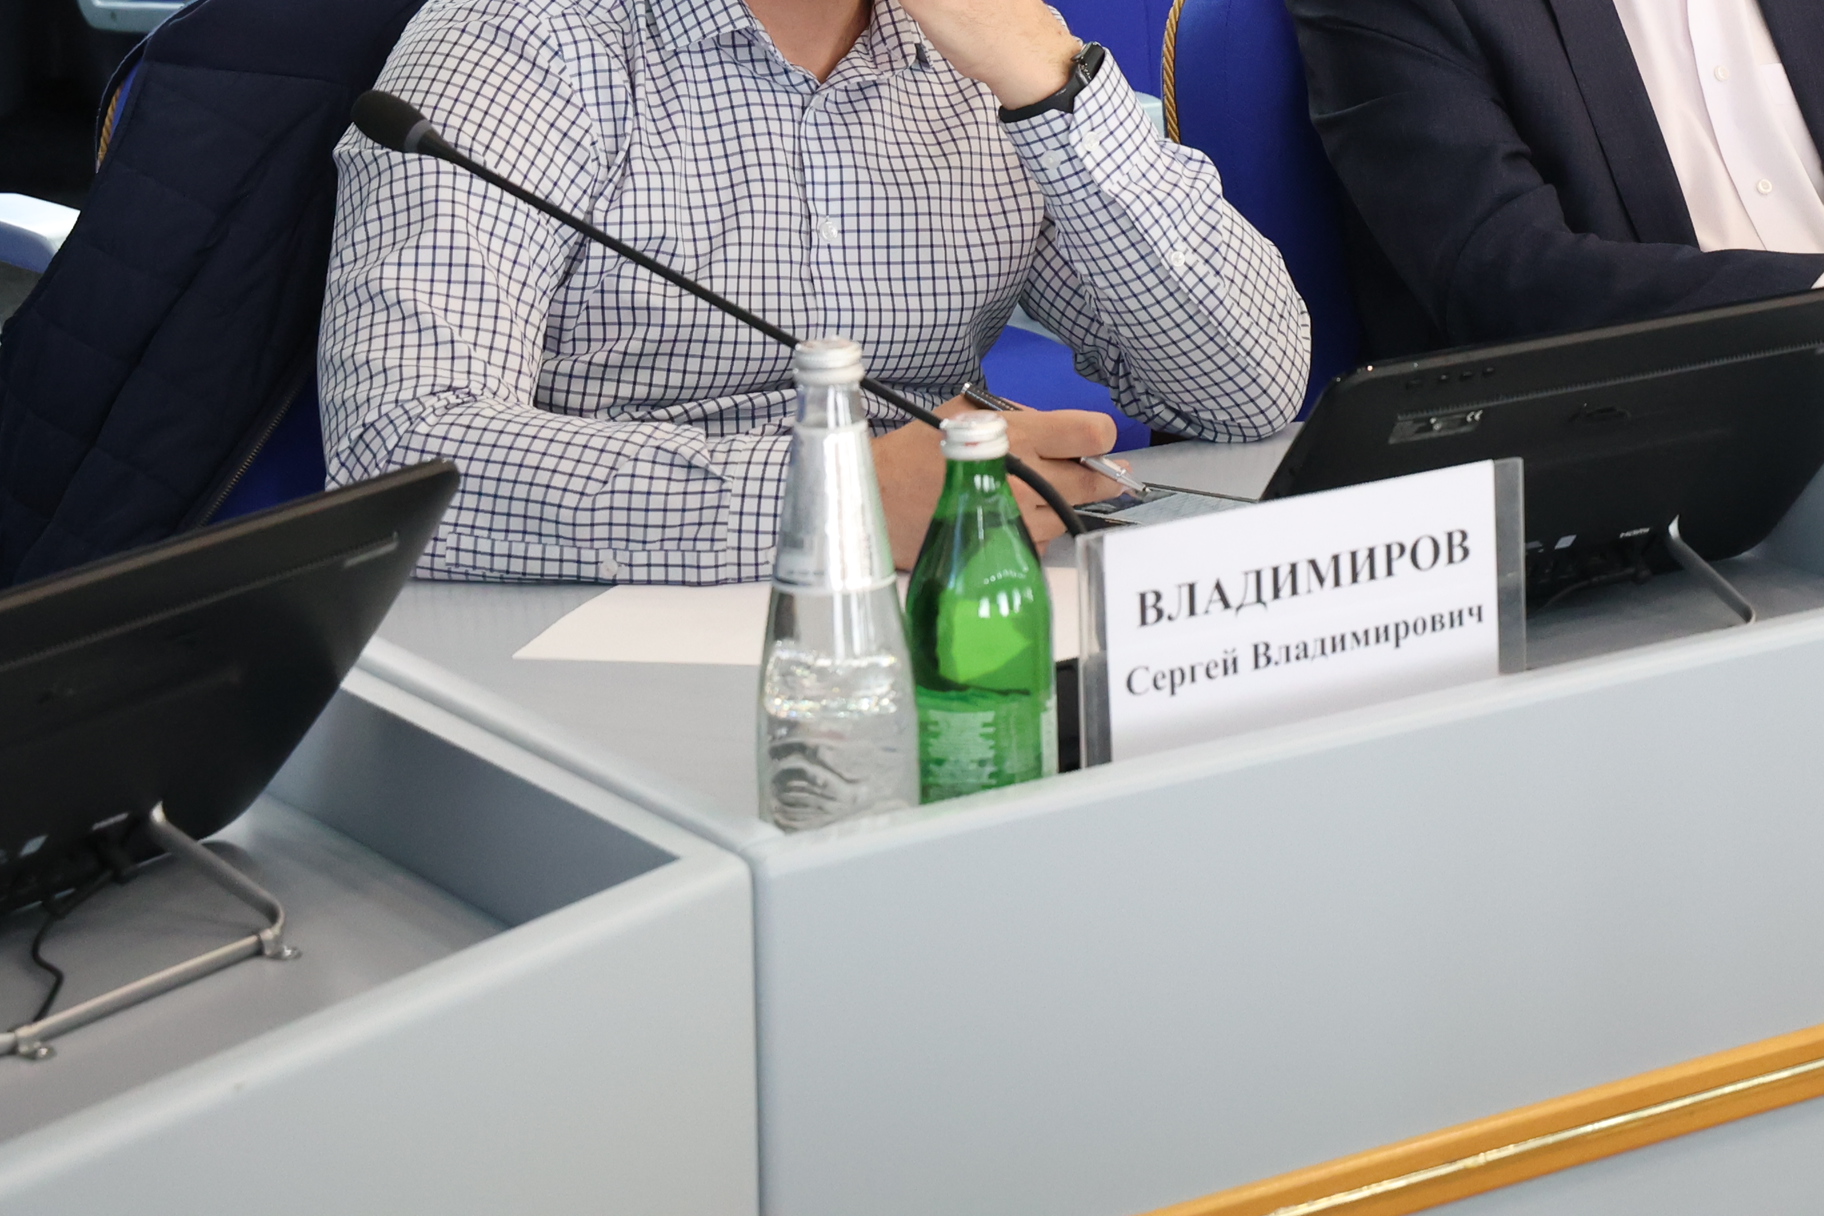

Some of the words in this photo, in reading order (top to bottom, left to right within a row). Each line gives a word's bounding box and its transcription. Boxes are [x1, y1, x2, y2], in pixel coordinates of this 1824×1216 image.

[1136, 528, 1471, 629] ВЛАДИМИРОВ
[1125, 647, 1239, 698] Сергей
[1252, 604, 1484, 671] Владимирович
